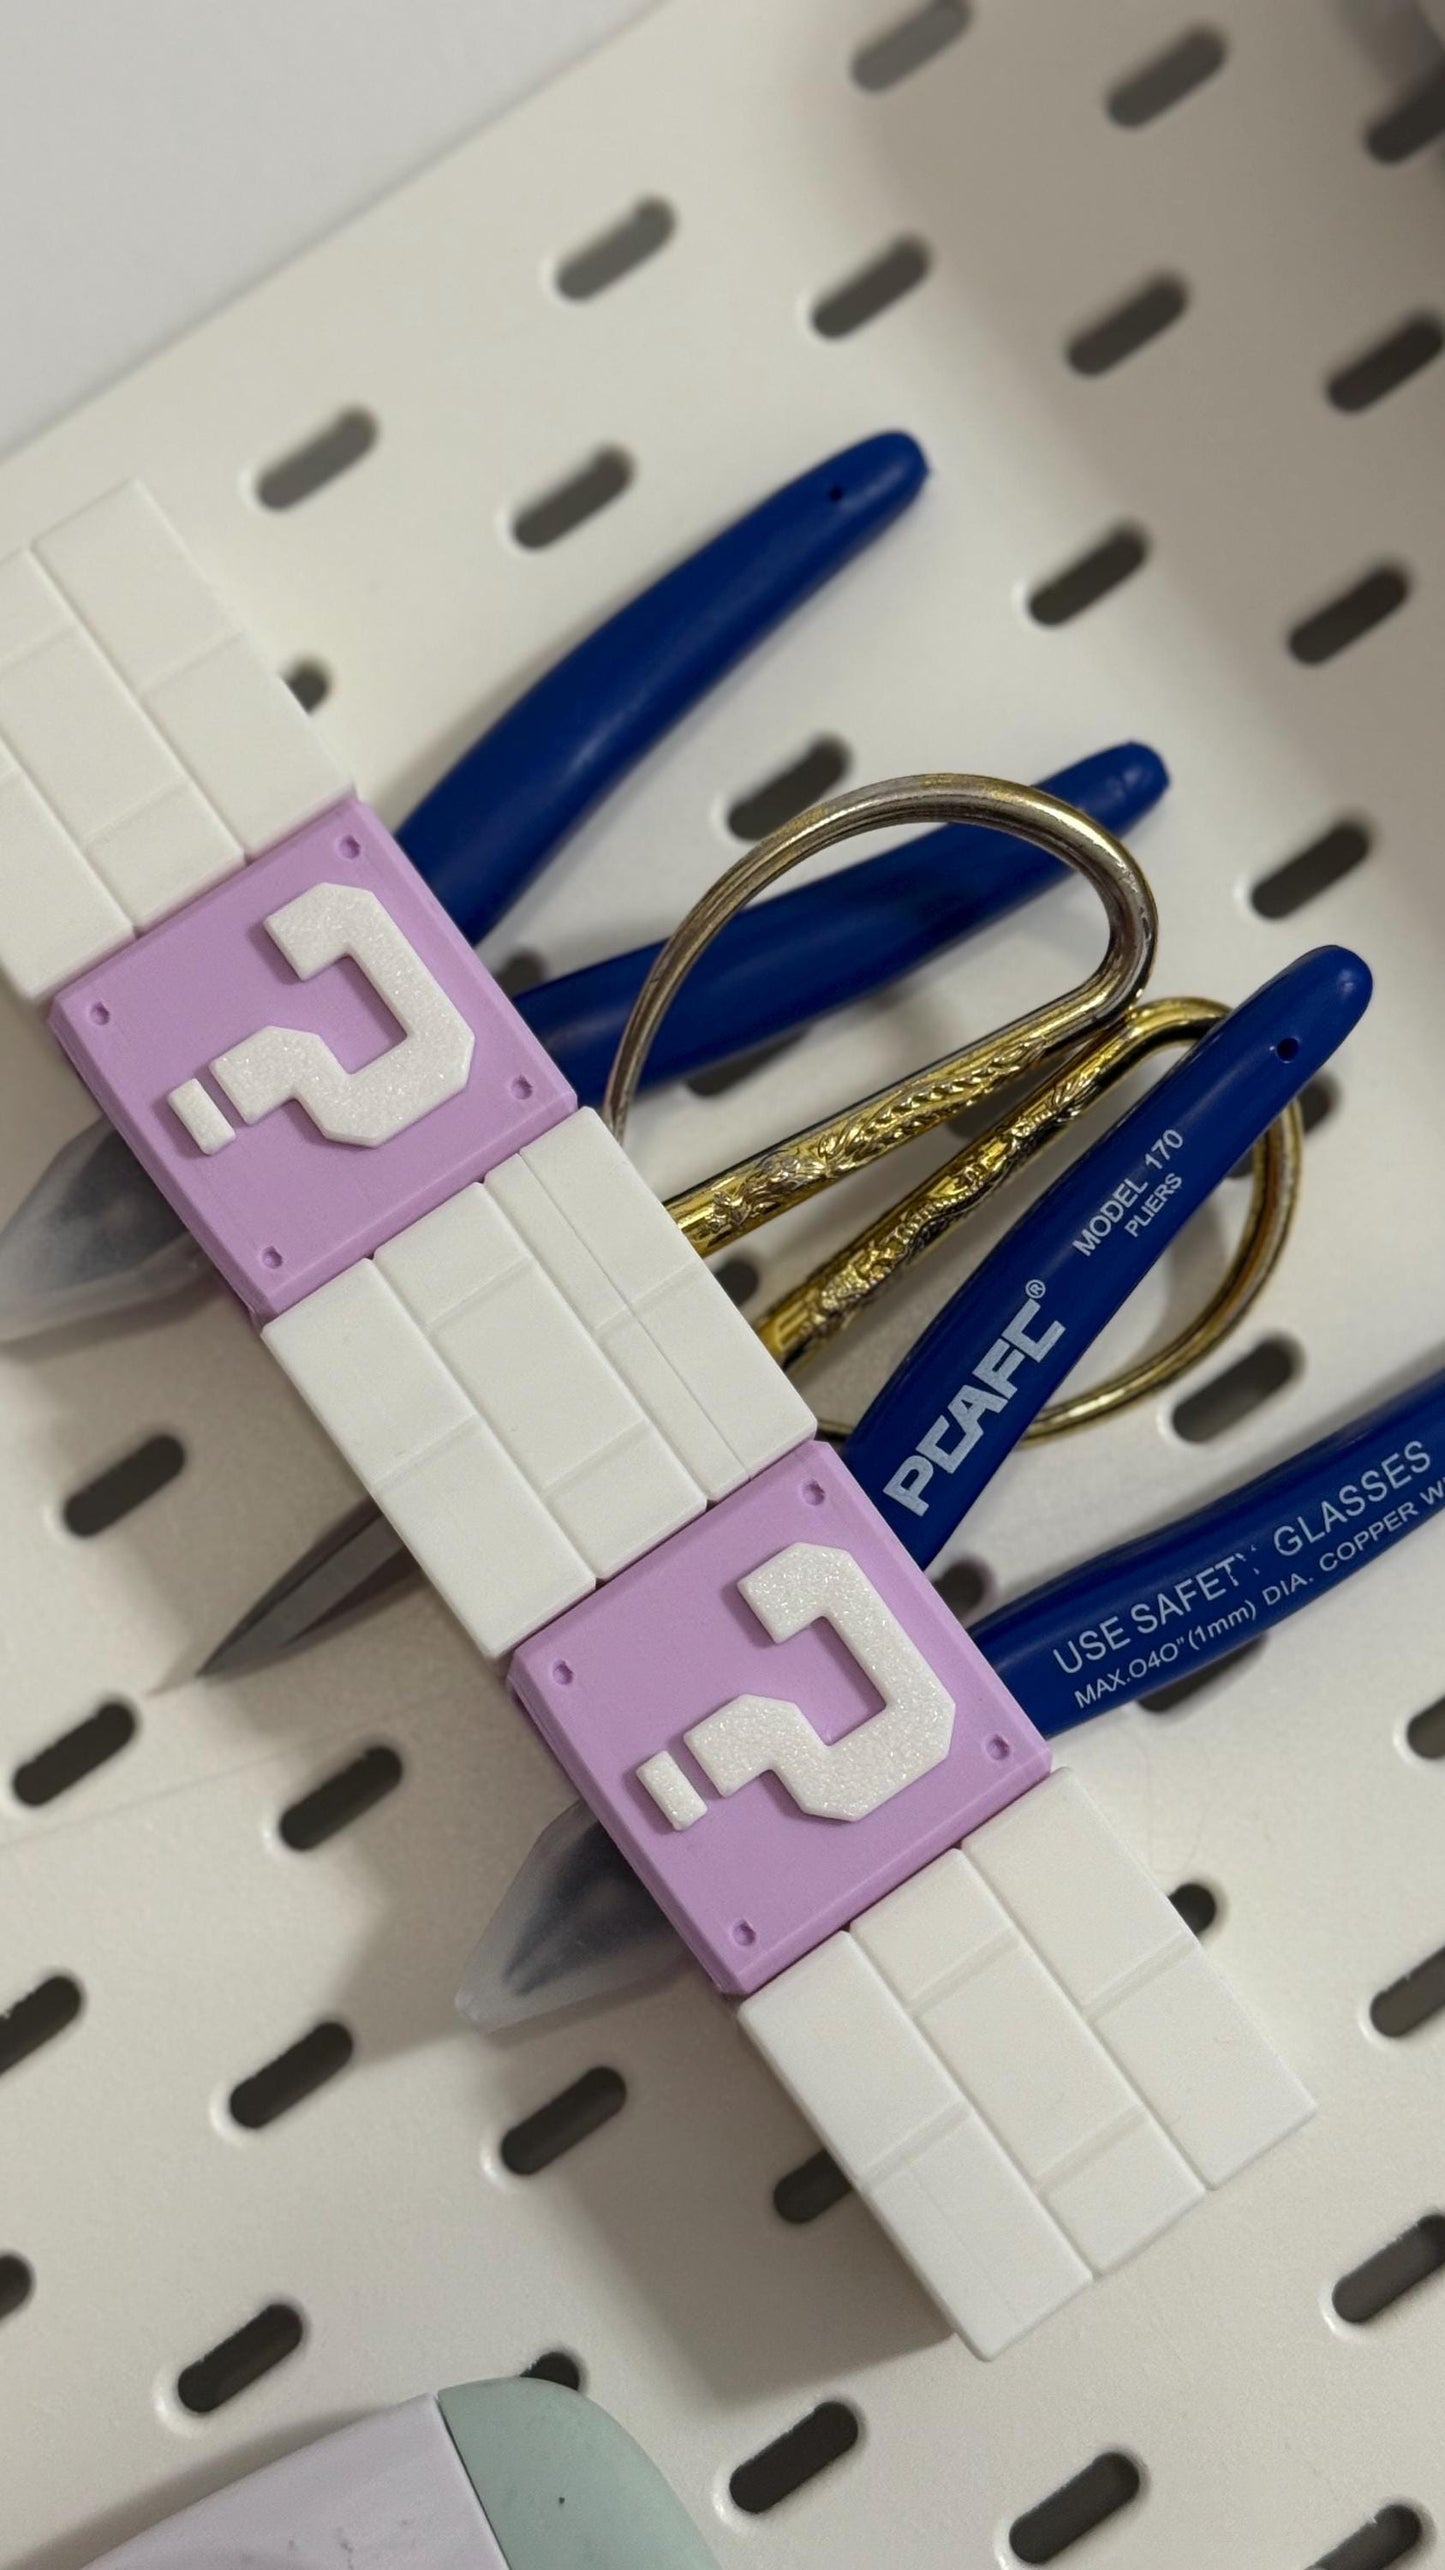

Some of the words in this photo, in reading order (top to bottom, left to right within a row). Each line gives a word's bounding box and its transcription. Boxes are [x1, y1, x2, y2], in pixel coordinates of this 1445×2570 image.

[1072, 1178, 1149, 1257] MODEL
[1145, 1129, 1184, 1171] 170
[1124, 1173, 1183, 1238] PLIERS
[1052, 1616, 1131, 1675] USE
[1273, 1441, 1431, 1556] GLASSES
[1262, 1573, 1315, 1606] DIA.
[1319, 1502, 1419, 1572] COPPER
[1419, 1477, 1445, 1505] W
